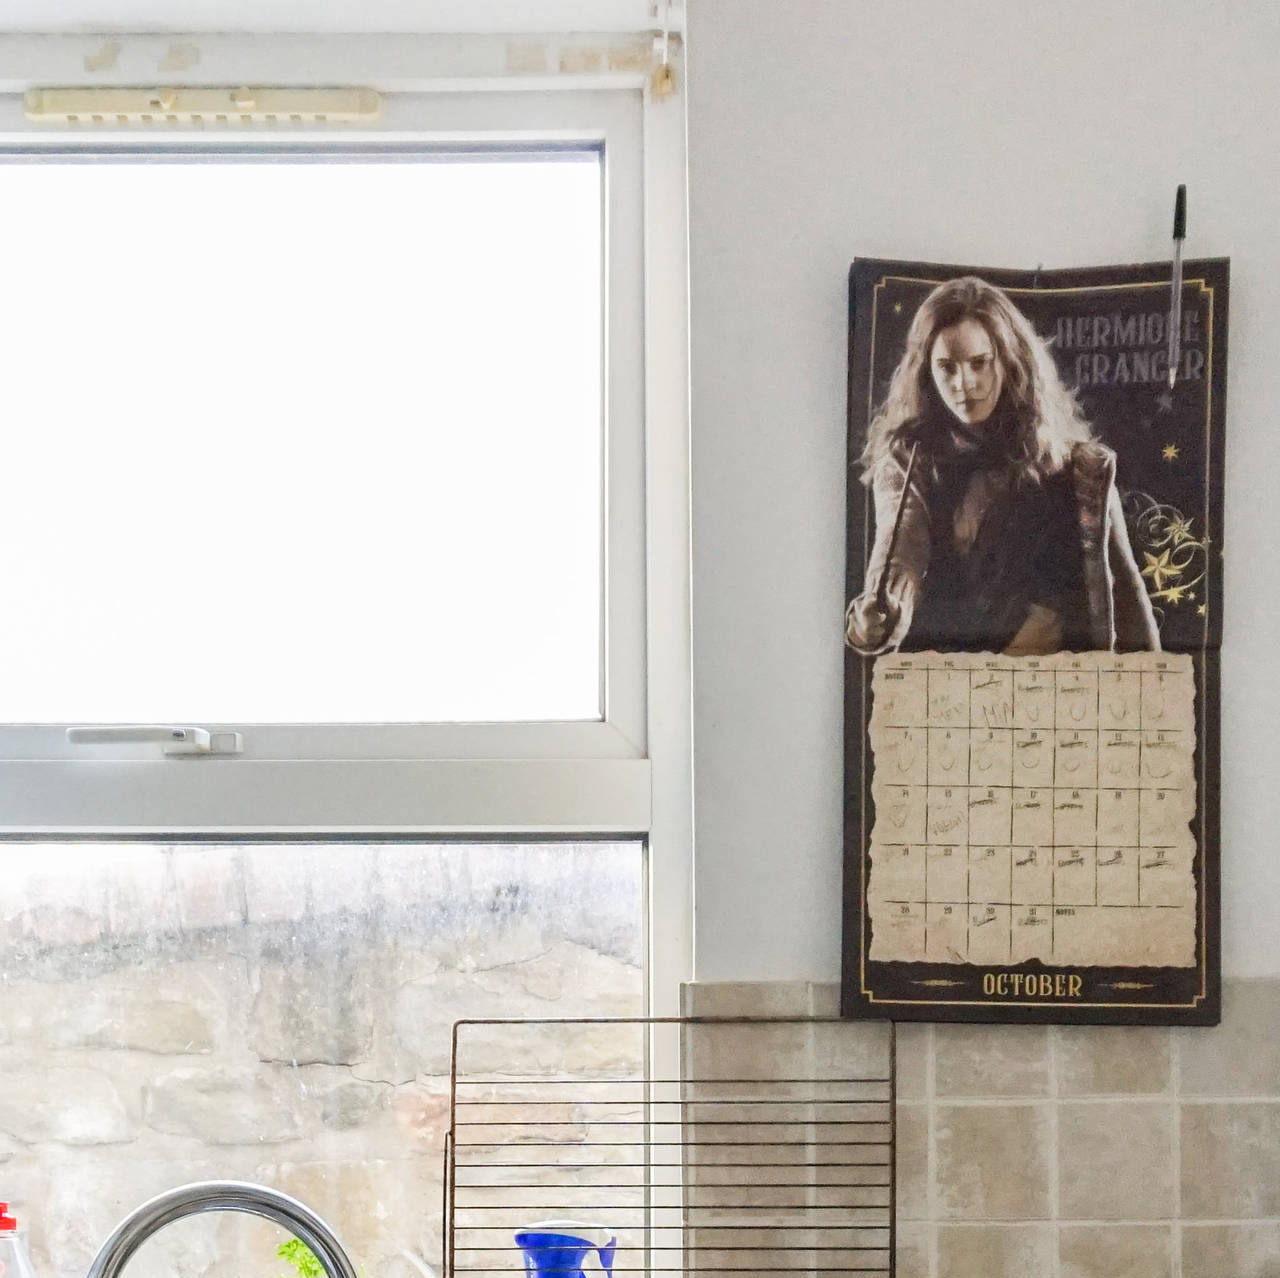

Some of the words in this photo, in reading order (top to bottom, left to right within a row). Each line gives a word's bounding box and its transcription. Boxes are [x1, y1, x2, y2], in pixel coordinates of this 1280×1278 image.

[1056, 310, 1200, 348] HERMIOE
[1075, 349, 1204, 385] GRANGR
[981, 972, 1083, 998] OCTOBER
